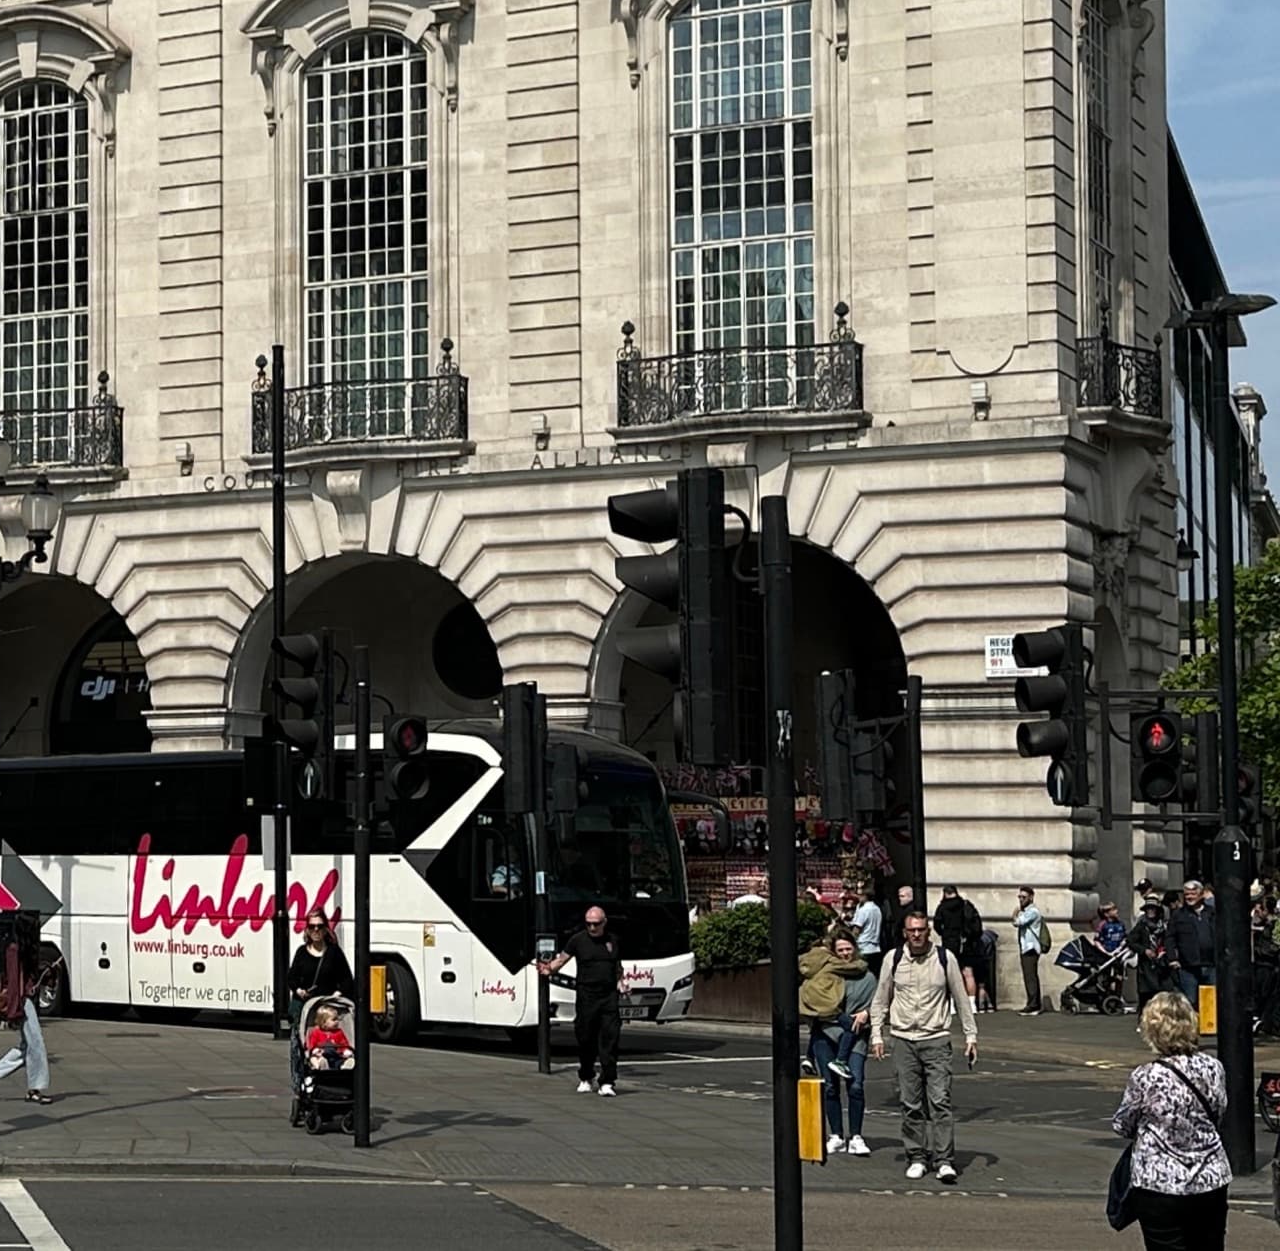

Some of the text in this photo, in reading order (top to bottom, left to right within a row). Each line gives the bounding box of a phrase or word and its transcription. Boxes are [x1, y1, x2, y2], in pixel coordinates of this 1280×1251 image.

[990, 638, 1011, 647] REGE
[134, 939, 245, 959] www.linburg.co.uk
[139, 980, 191, 1003] Together
[195, 987, 214, 1000] we
[218, 988, 239, 1001] can
